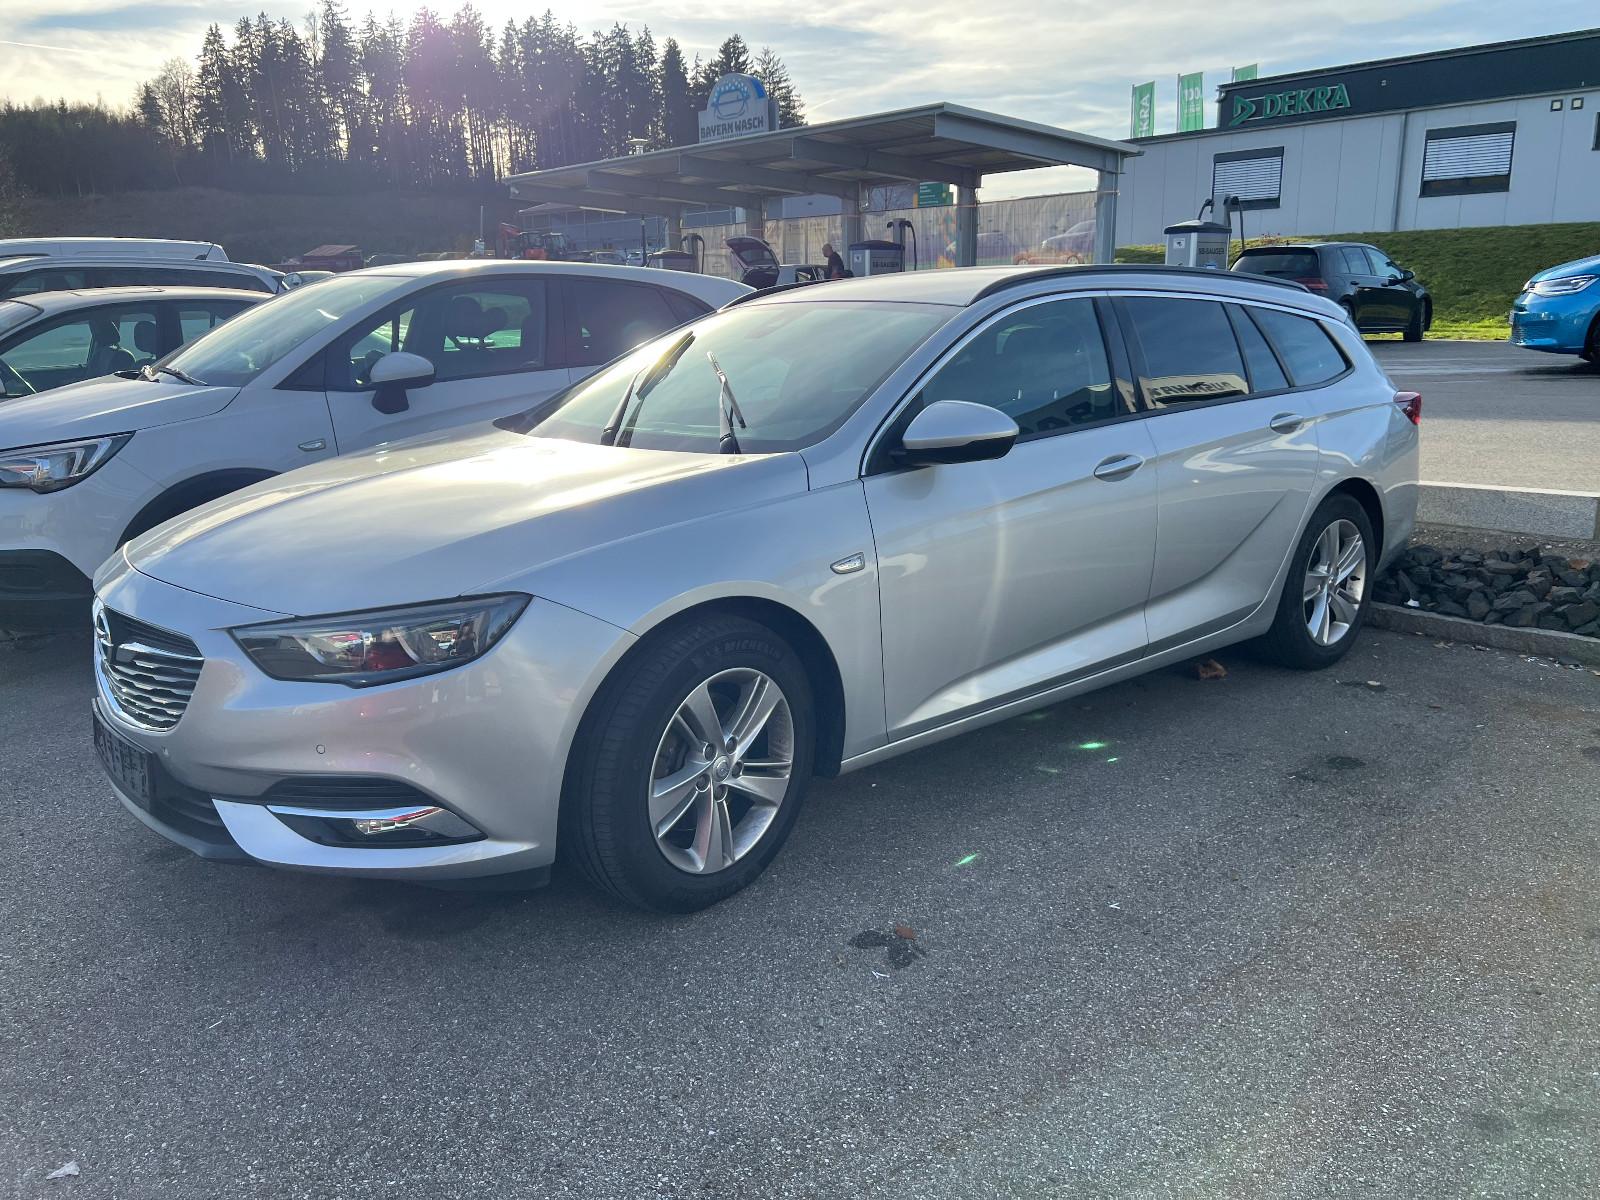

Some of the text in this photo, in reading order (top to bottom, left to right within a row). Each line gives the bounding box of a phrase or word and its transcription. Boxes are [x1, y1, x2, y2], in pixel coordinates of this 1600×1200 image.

[1263, 83, 1350, 118] DEKRA
[701, 121, 733, 138] BAYERN
[735, 116, 764, 131] WASCH
